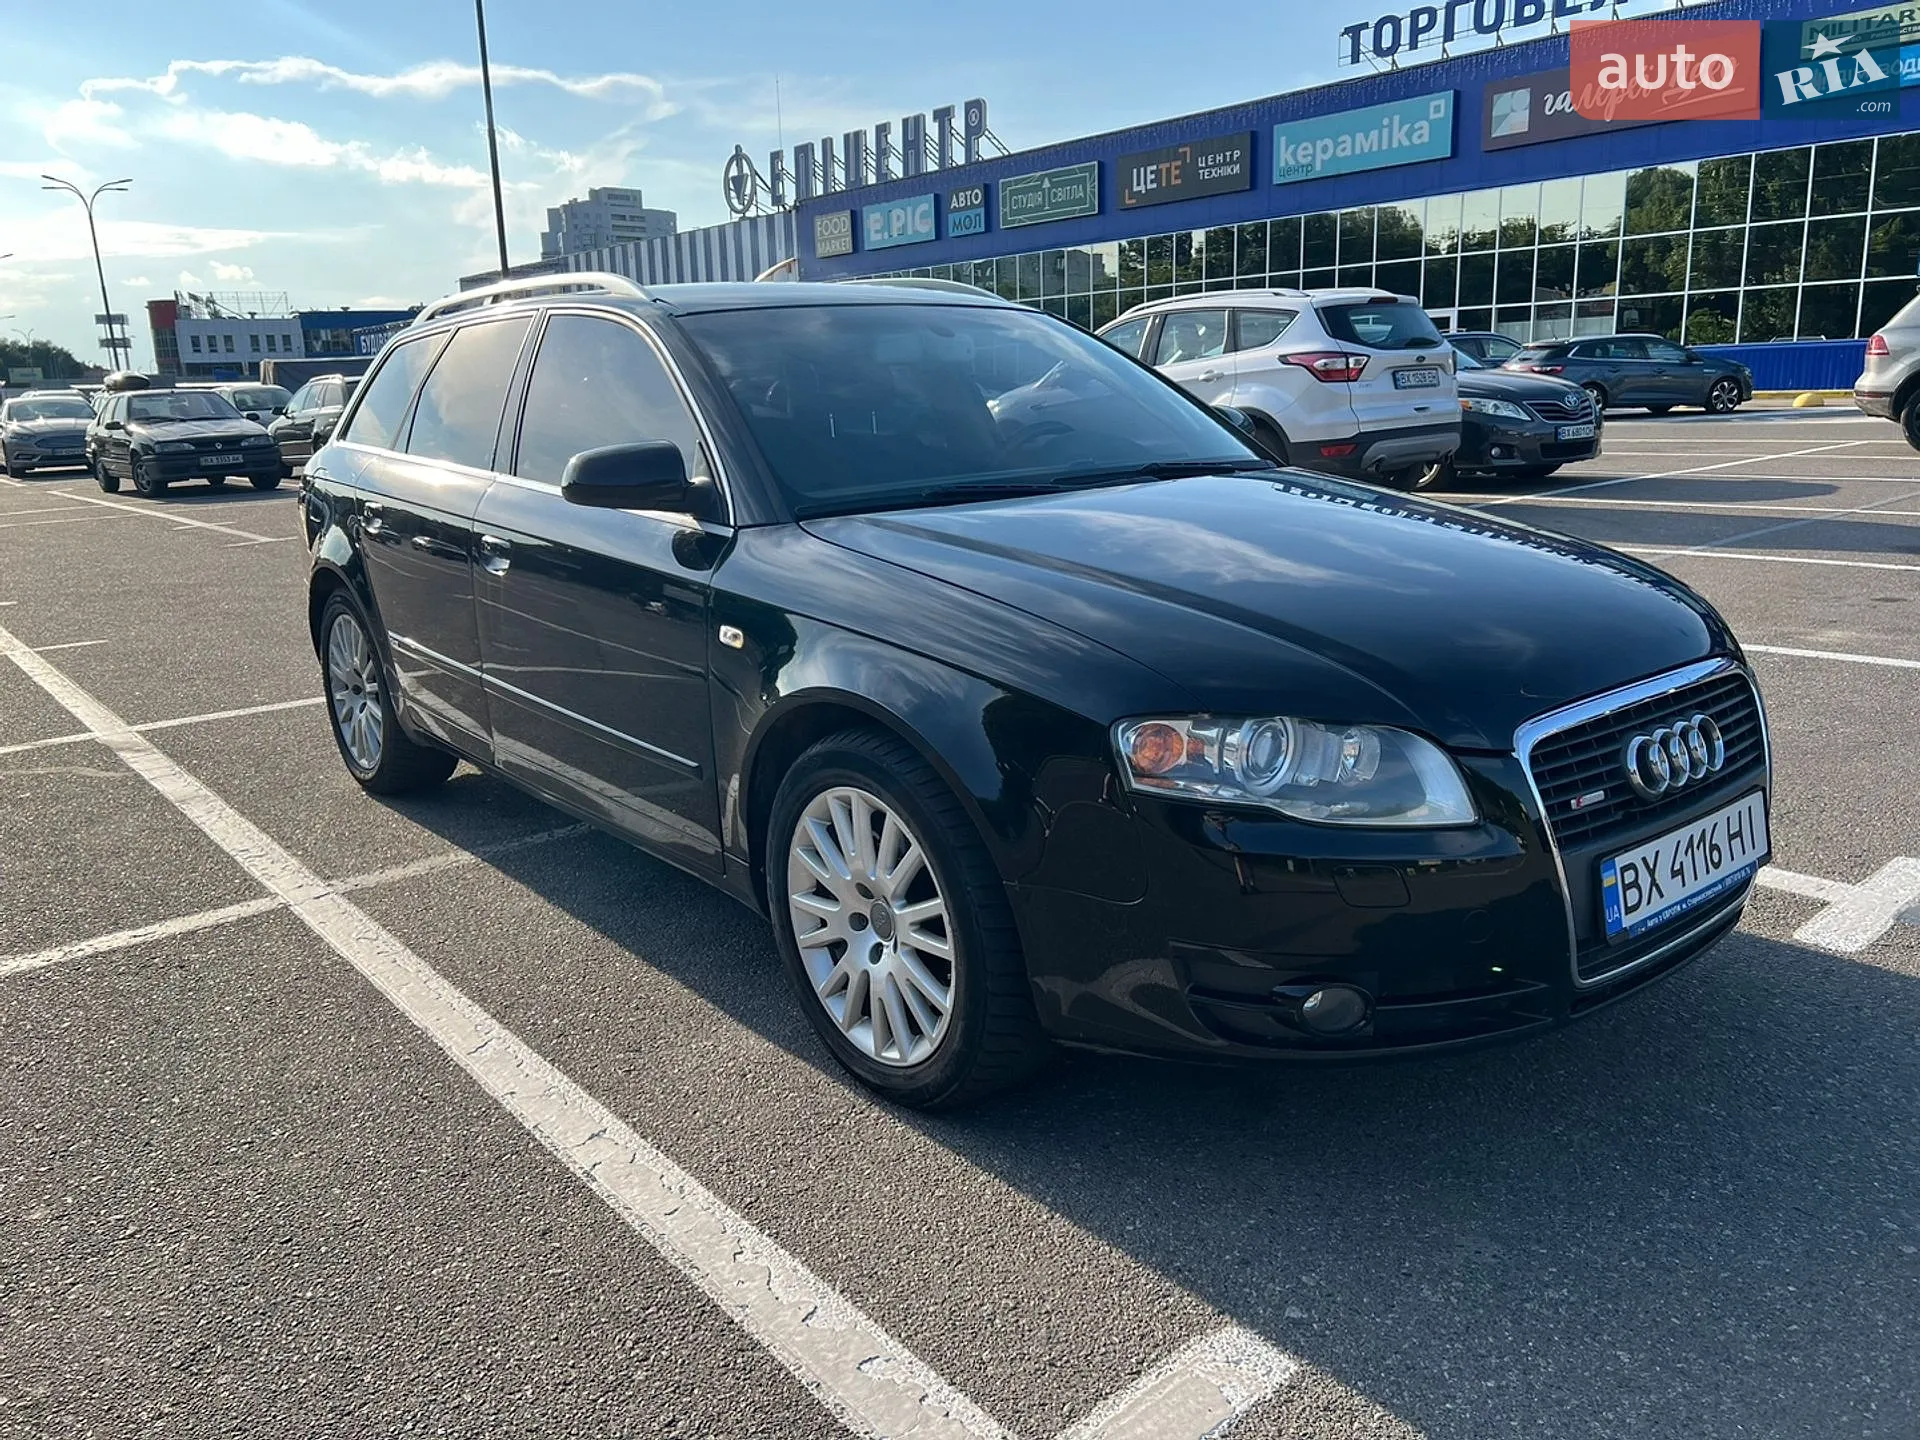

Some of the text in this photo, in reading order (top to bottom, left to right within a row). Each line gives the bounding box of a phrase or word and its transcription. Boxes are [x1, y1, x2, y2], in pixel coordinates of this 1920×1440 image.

[1809, 8, 1920, 41] MILITAR
[770, 97, 987, 207] ЕПІЦЕНТР
[1197, 149, 1241, 168] ЦЕНТР
[1132, 160, 1182, 194] ЦЕТЕ
[1198, 163, 1241, 180] ТЕХНІКИ
[950, 188, 982, 209] АВТО
[1050, 183, 1085, 203] СВІТЛА
[816, 216, 849, 237] FOOD
[951, 213, 982, 234] МОЛ
[818, 236, 850, 253] MARKET
[1619, 805, 1756, 916] BX 4116 HI
[1606, 904, 1621, 923] UA
